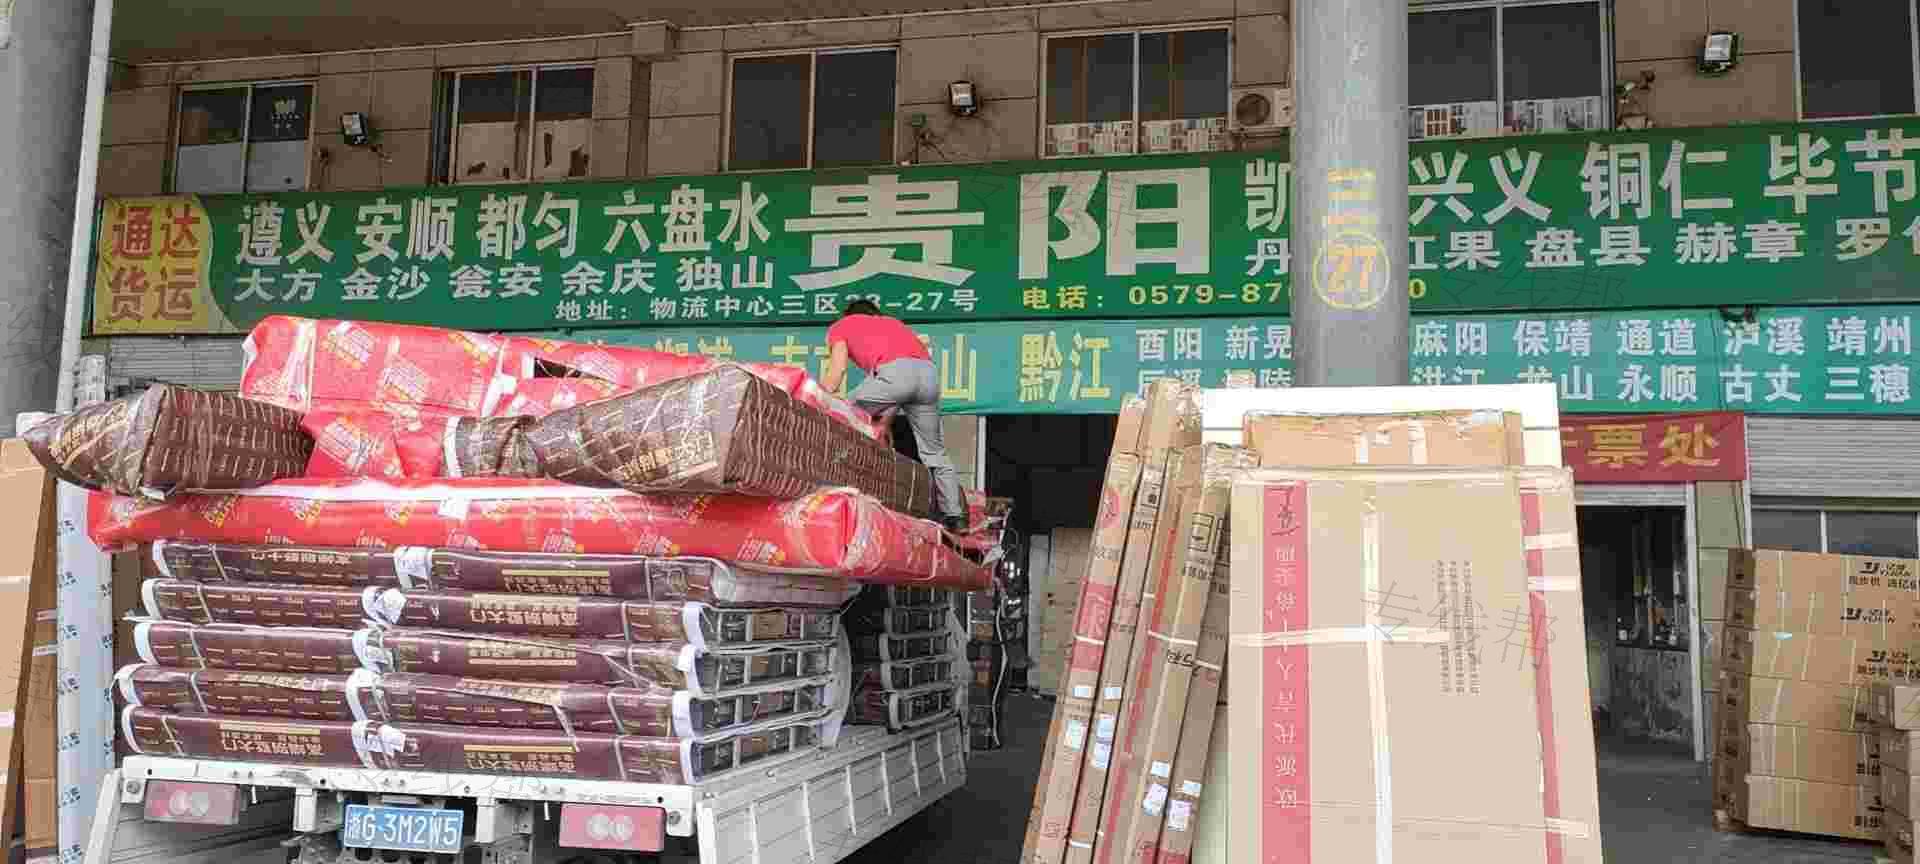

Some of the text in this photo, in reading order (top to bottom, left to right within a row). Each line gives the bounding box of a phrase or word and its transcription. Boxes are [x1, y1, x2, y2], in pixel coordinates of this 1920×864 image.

[1408, 147, 1553, 225] 兴义
[1580, 139, 1734, 220] 铜仁
[1763, 127, 1917, 214] 毕节
[110, 203, 200, 259] 通达
[235, 181, 771, 264] 遵义 安顺 都匀 六盘水
[784, 166, 1211, 291] 贵阳
[1524, 225, 1651, 269] 盘县
[1674, 220, 1806, 264] 赫章
[110, 264, 197, 321] 货运
[234, 254, 774, 302] 大方 金沙 瓮安 余庆 独山
[1327, 244, 1378, 301] 27
[1136, 315, 1912, 362] 酉阳 新晃 麻阳 保靖 通道 泸溪 靖州
[1020, 331, 1112, 403] 黔江
[1617, 364, 1697, 402] 永顺
[1719, 363, 1803, 403] 古丈
[1824, 362, 1912, 403] 三穗
[1563, 422, 1721, 471] 票处
